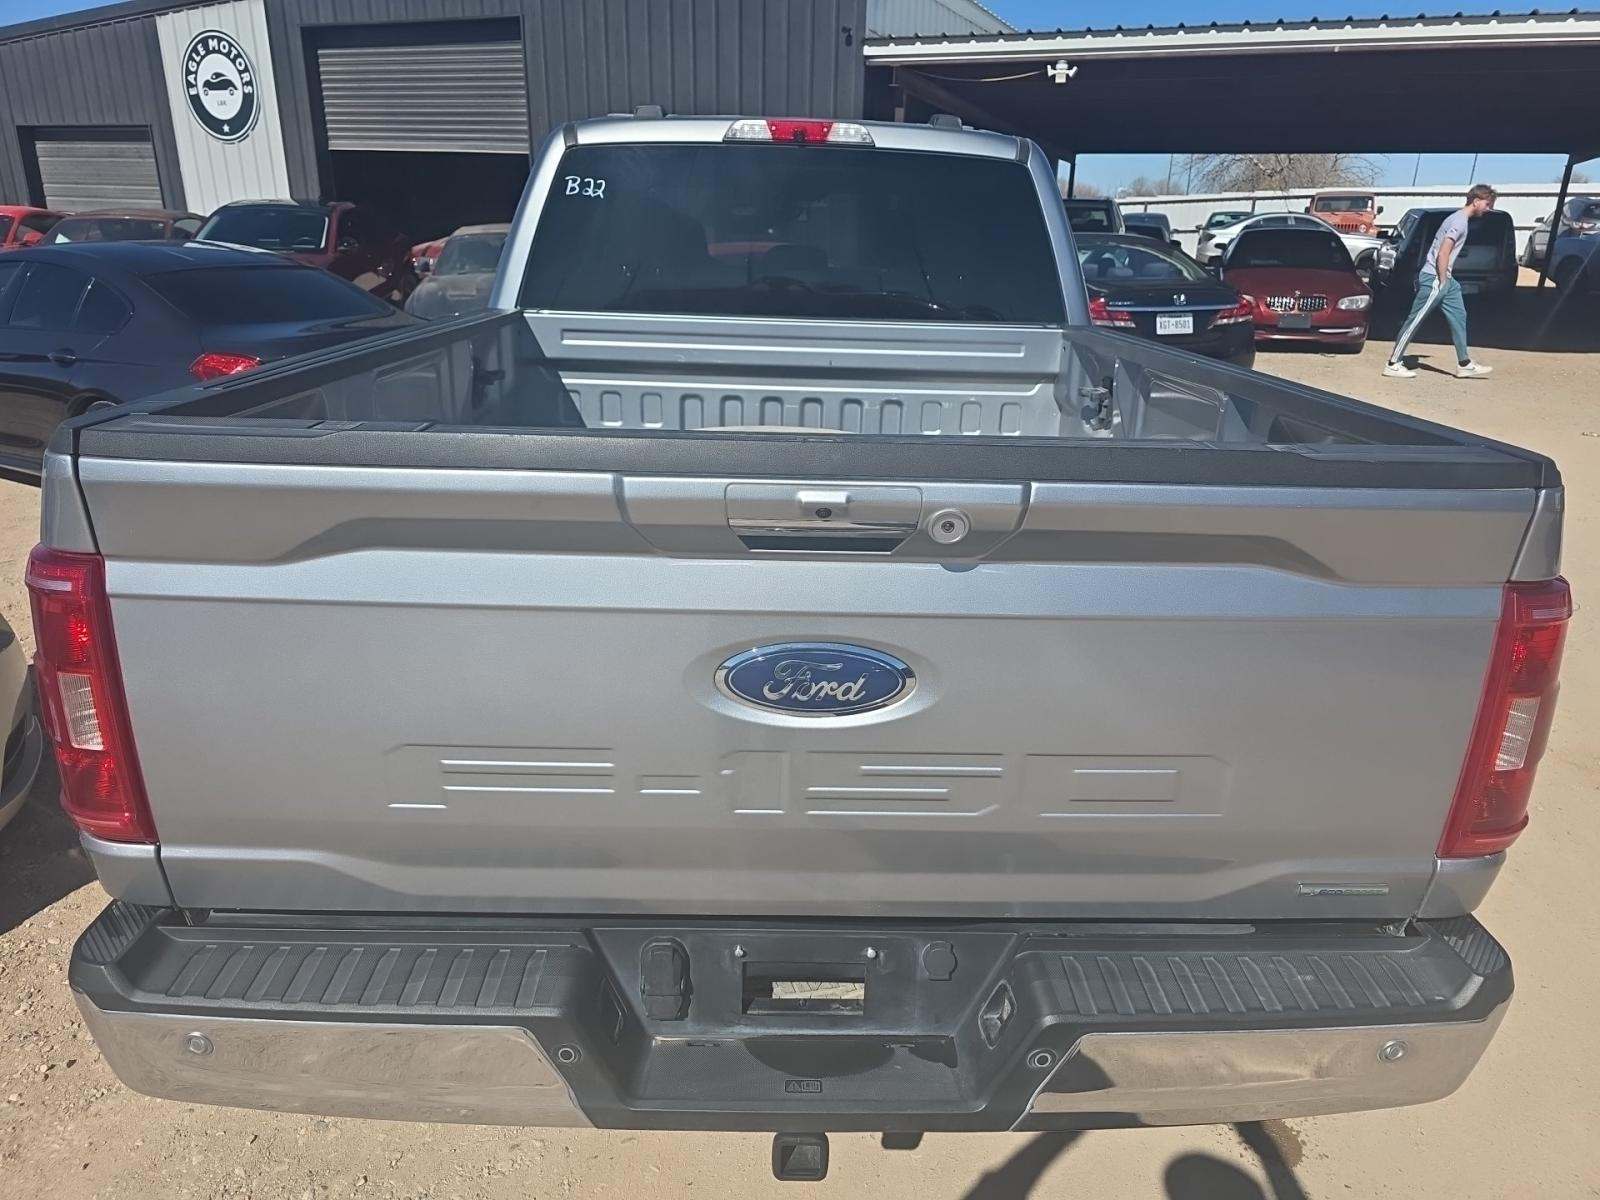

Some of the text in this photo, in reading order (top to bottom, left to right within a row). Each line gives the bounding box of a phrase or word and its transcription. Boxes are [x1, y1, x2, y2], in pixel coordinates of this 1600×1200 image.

[187, 38, 252, 95] EAGLE MOTORS
[565, 176, 605, 199] B22
[762, 659, 869, 701] Ford
[384, 743, 1231, 819] F-150
